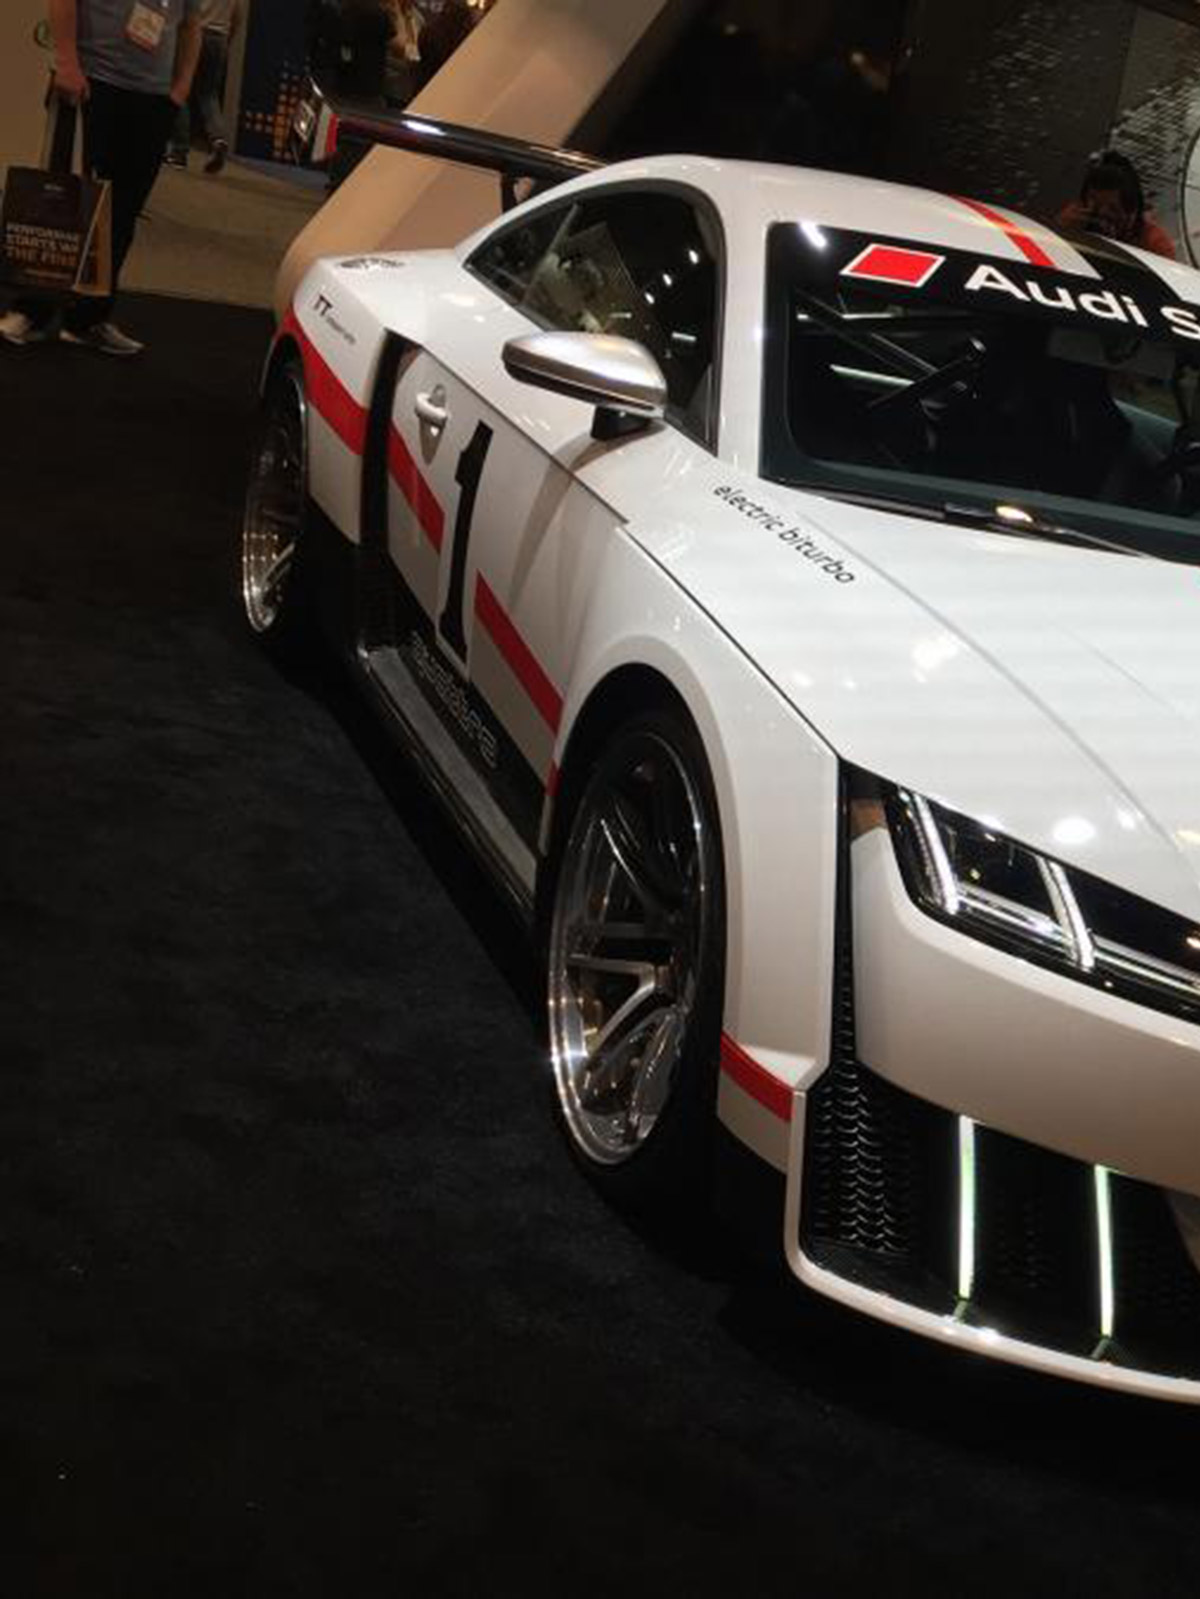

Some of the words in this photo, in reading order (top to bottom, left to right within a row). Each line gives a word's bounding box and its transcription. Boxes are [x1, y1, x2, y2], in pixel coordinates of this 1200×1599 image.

[964, 263, 1150, 328] Audi
[713, 484, 785, 532] electric
[777, 526, 857, 585] biturbo
